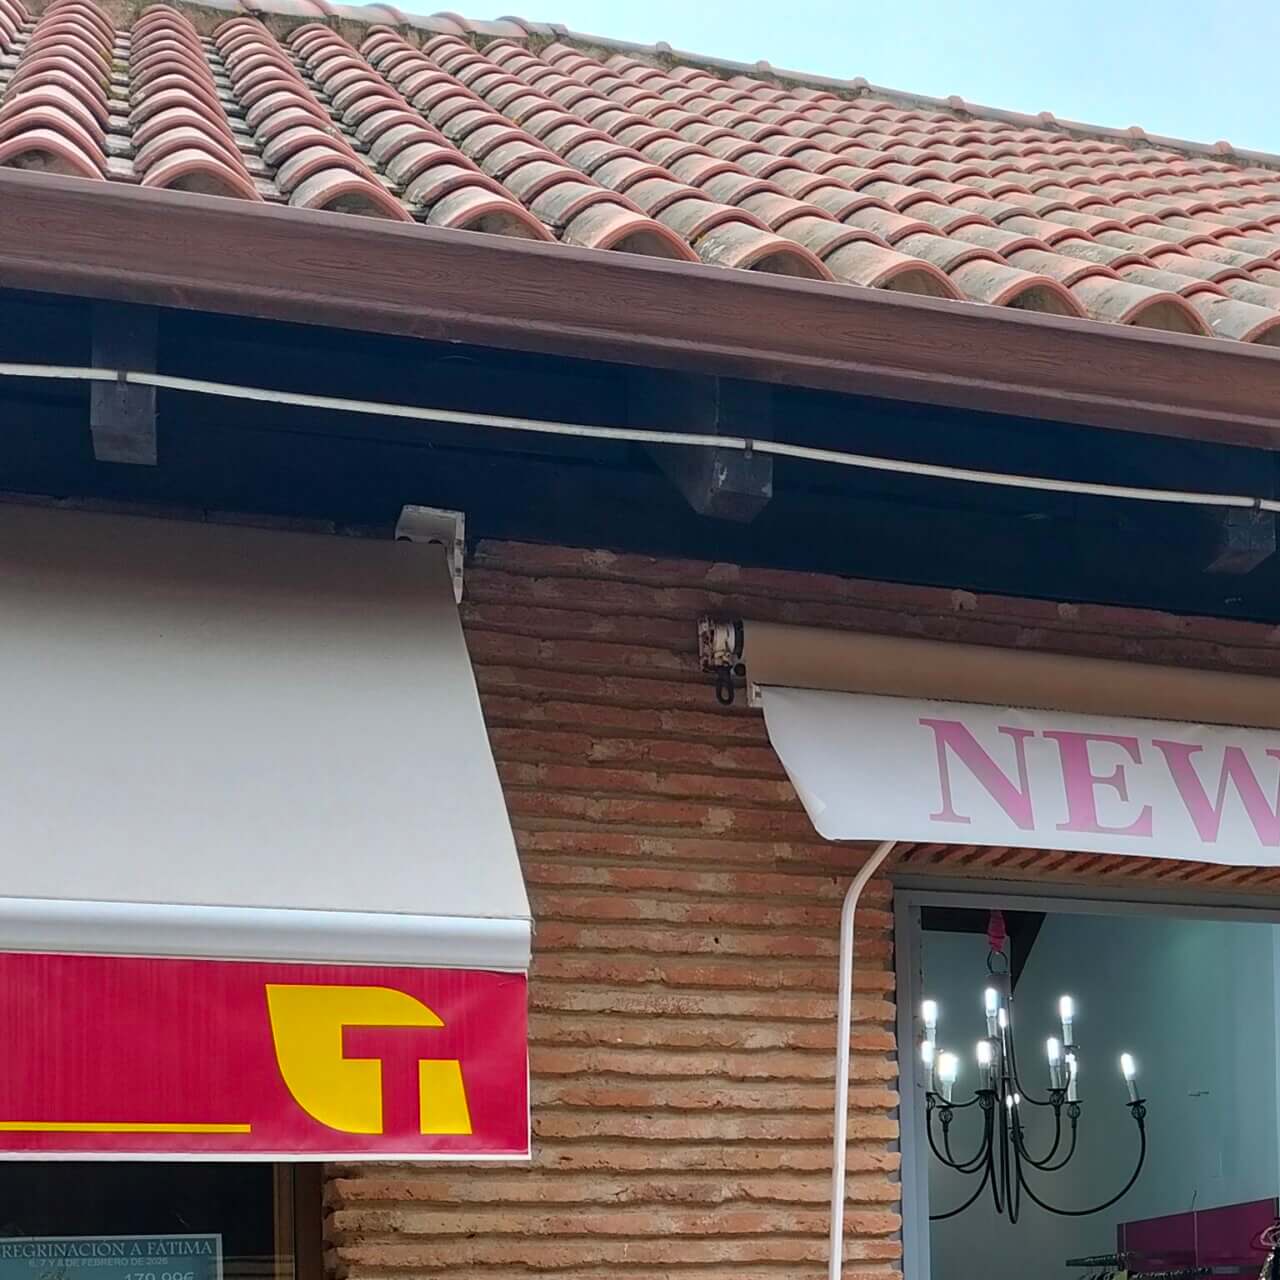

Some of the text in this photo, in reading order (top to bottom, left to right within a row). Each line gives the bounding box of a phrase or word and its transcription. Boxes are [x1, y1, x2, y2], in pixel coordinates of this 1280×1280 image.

[0, 1239, 213, 1258] REGRINACIÓN A FÁTIMA
[131, 1257, 145, 1265] DE
